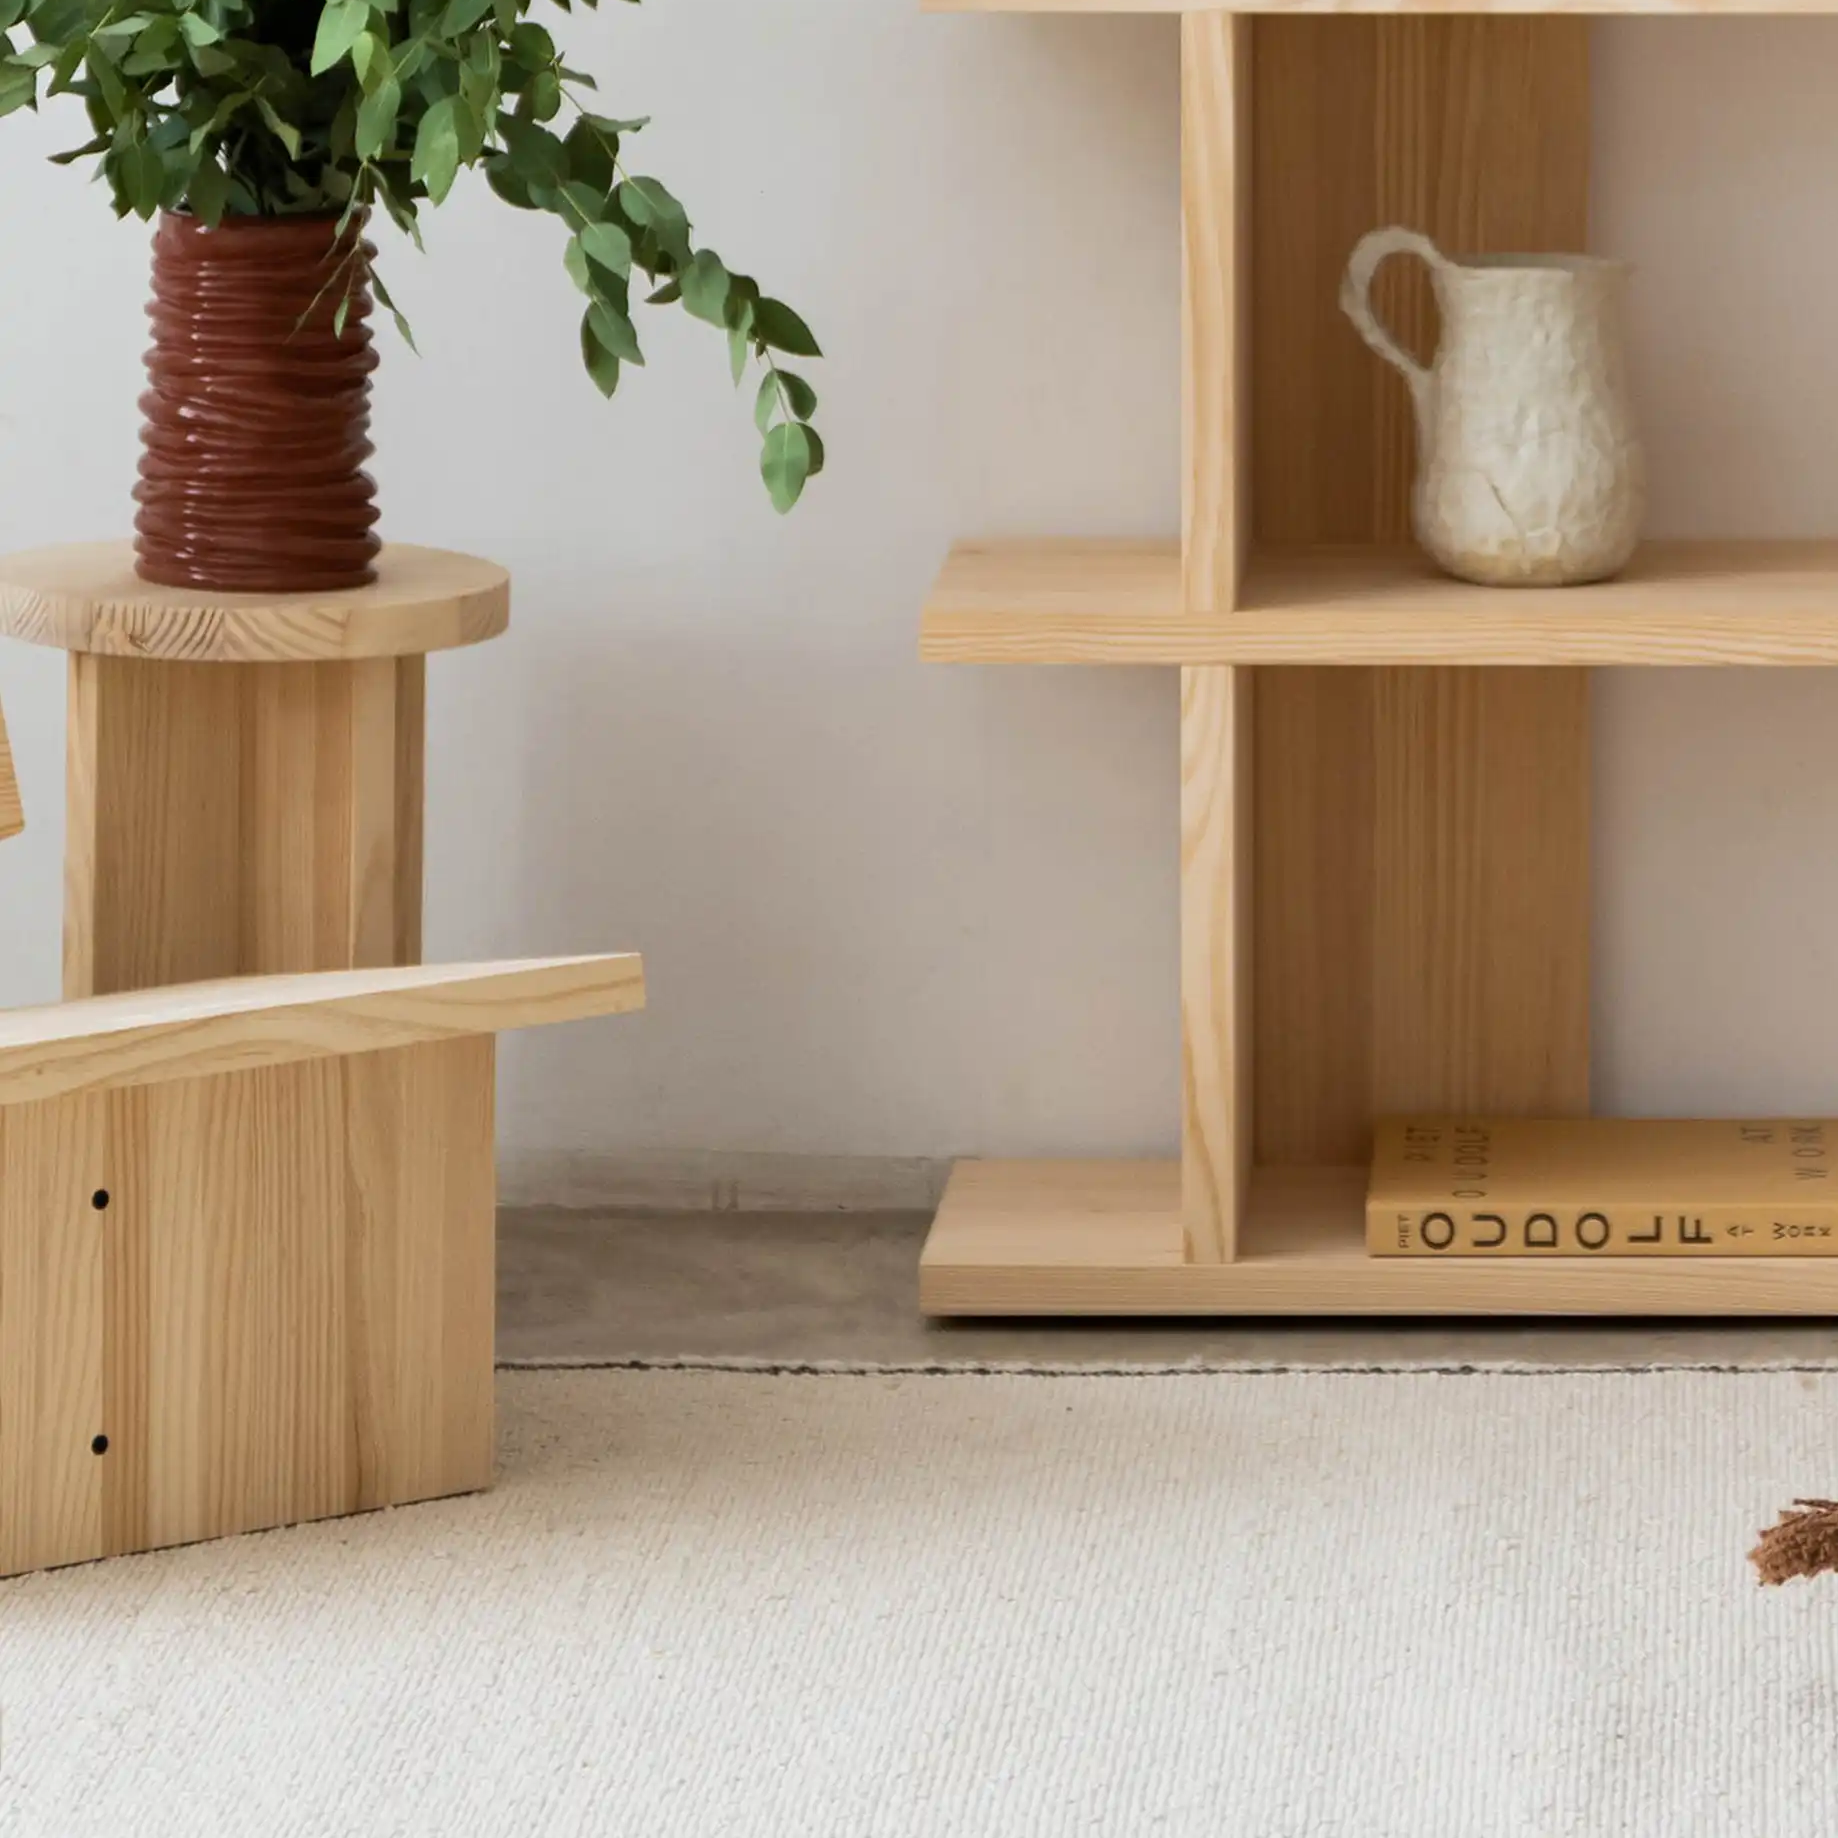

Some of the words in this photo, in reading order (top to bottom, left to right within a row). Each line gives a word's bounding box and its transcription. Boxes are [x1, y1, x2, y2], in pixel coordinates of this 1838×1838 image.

[1740, 1127, 1775, 1144] AT
[1789, 1126, 1828, 1180] WORK
[1398, 1213, 1410, 1249] PIET
[1420, 1212, 1713, 1250] OUDOLF
